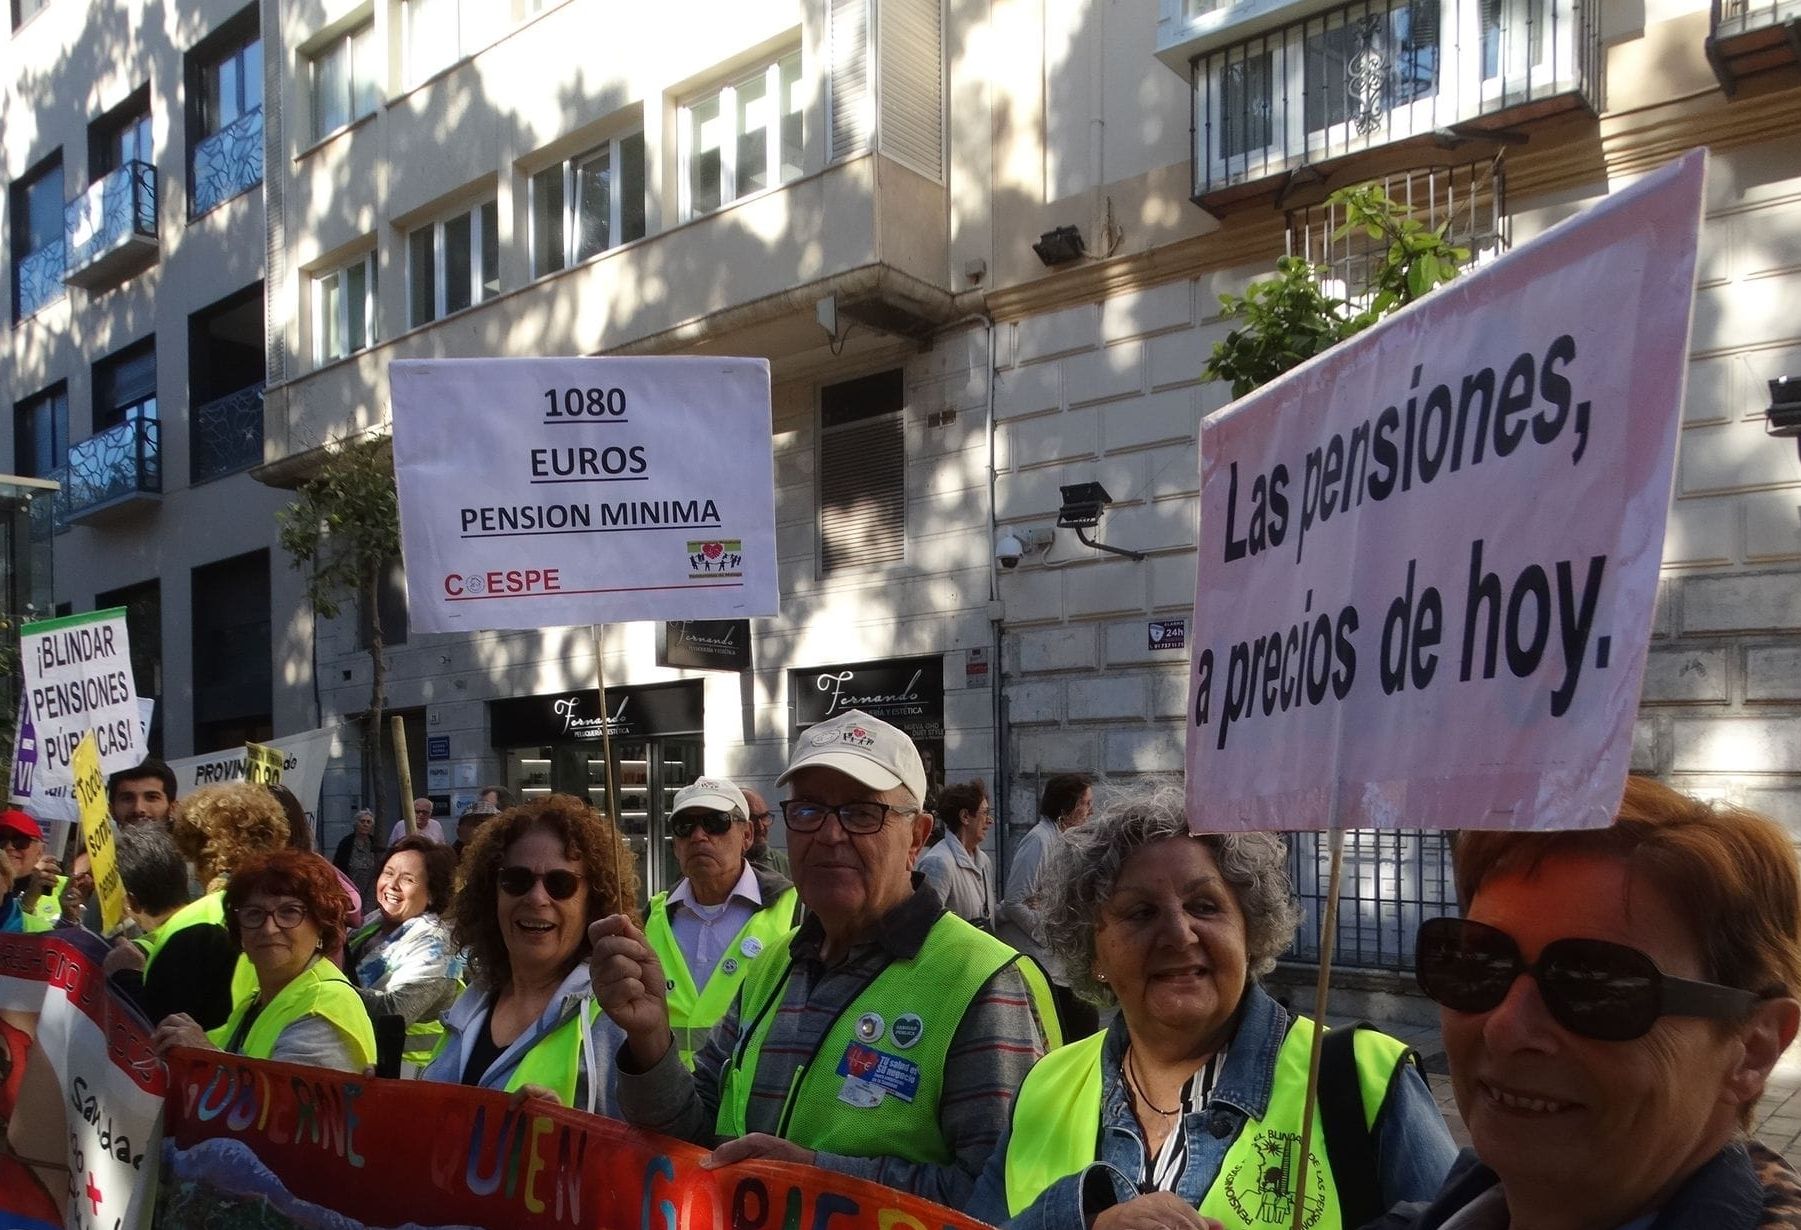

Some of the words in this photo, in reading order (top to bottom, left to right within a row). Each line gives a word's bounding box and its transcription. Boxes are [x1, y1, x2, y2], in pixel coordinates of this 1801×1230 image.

[544, 387, 627, 417] 1080
[531, 446, 648, 477] EUROS
[1223, 461, 1290, 563] Las
[1296, 334, 1592, 565] pensiones,
[461, 503, 591, 532] PENSION
[601, 499, 721, 526] MINIMA
[36, 625, 116, 679] ¡BLINDAR
[1194, 644, 1214, 727] a
[1217, 590, 1360, 750] precios
[1380, 559, 1442, 696] de
[1459, 539, 1612, 719] hoy.
[33, 671, 129, 721] PENSIONES
[817, 669, 922, 715] Fernando
[1267, 1129, 1304, 1146] BLINDA
[1308, 1152, 1321, 1168] DE
[1316, 1170, 1325, 1191] LAS
